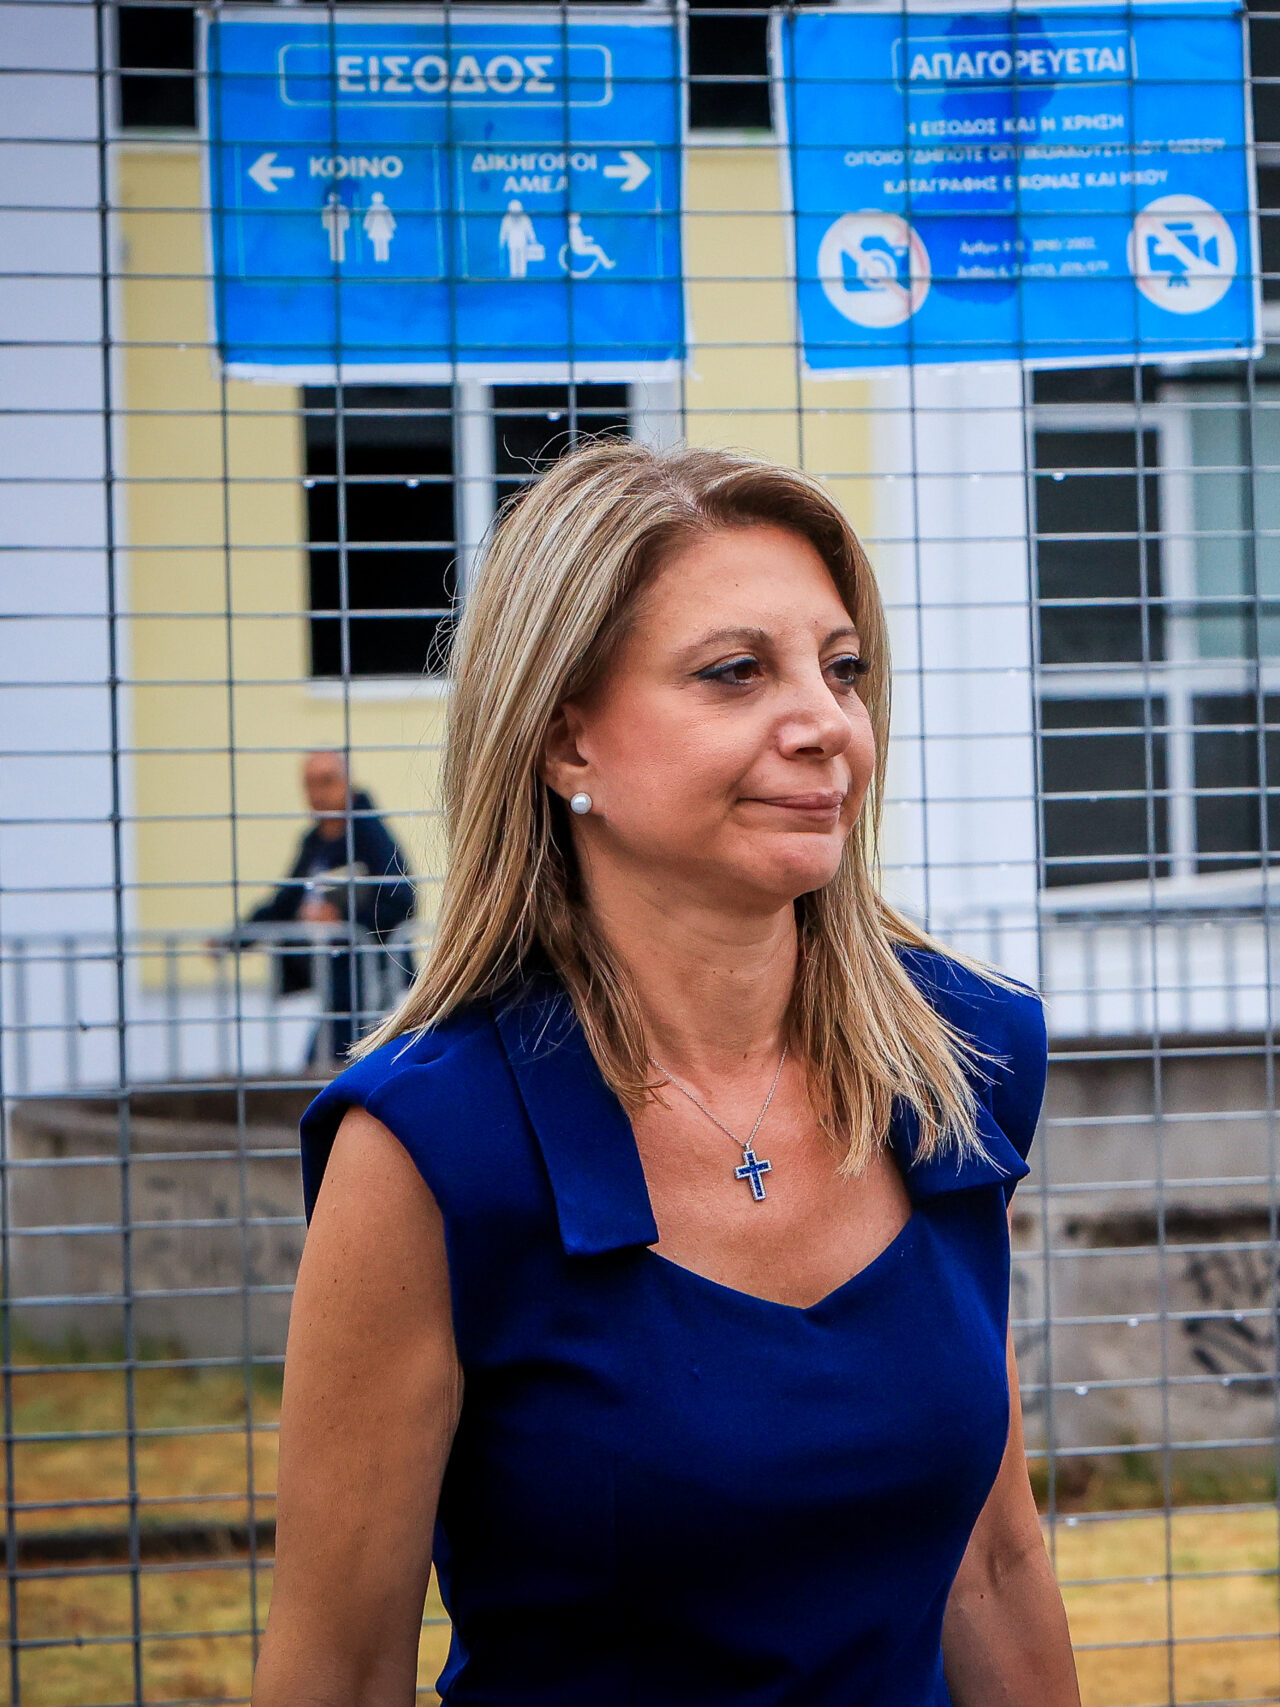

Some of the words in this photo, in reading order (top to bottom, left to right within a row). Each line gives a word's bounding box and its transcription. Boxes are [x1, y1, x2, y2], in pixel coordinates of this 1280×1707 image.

[337, 54, 556, 93] ΕΙΣΟΔΟΣ
[909, 46, 1126, 80] ΑΠΑΓΟΡΕΥΕΤΑΙ
[309, 155, 403, 178] ΚΟΙΝΟ
